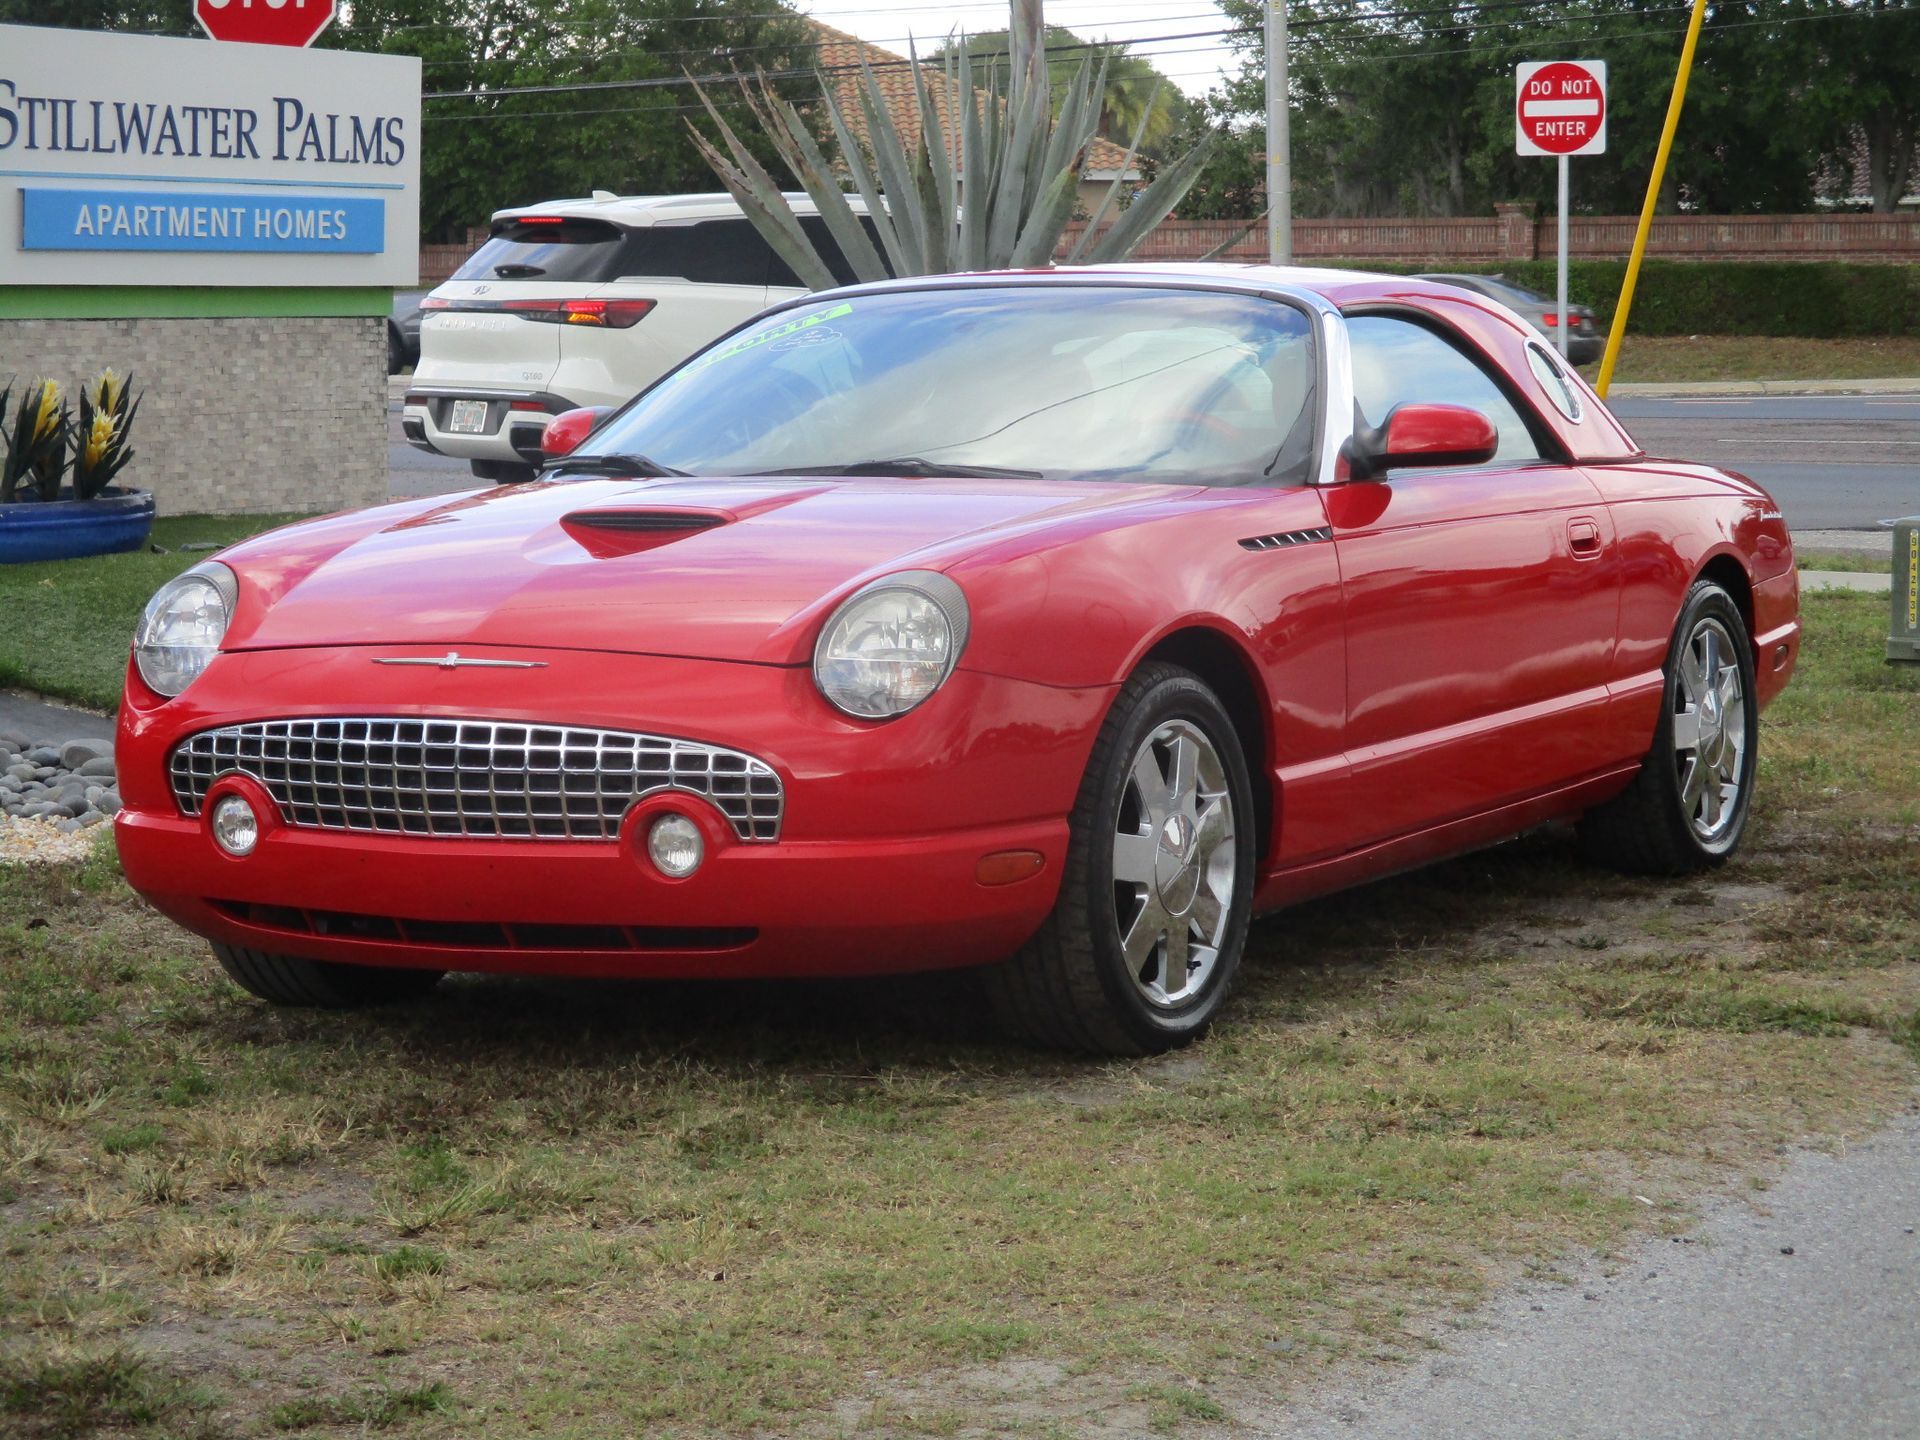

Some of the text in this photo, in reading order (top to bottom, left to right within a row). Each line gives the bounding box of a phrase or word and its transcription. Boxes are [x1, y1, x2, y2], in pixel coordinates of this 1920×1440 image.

[1530, 80, 1592, 95] DO NOT
[272, 97, 405, 167] PALMS
[1535, 121, 1586, 136] ENTER
[74, 204, 347, 241] APARTMENT HOMES
